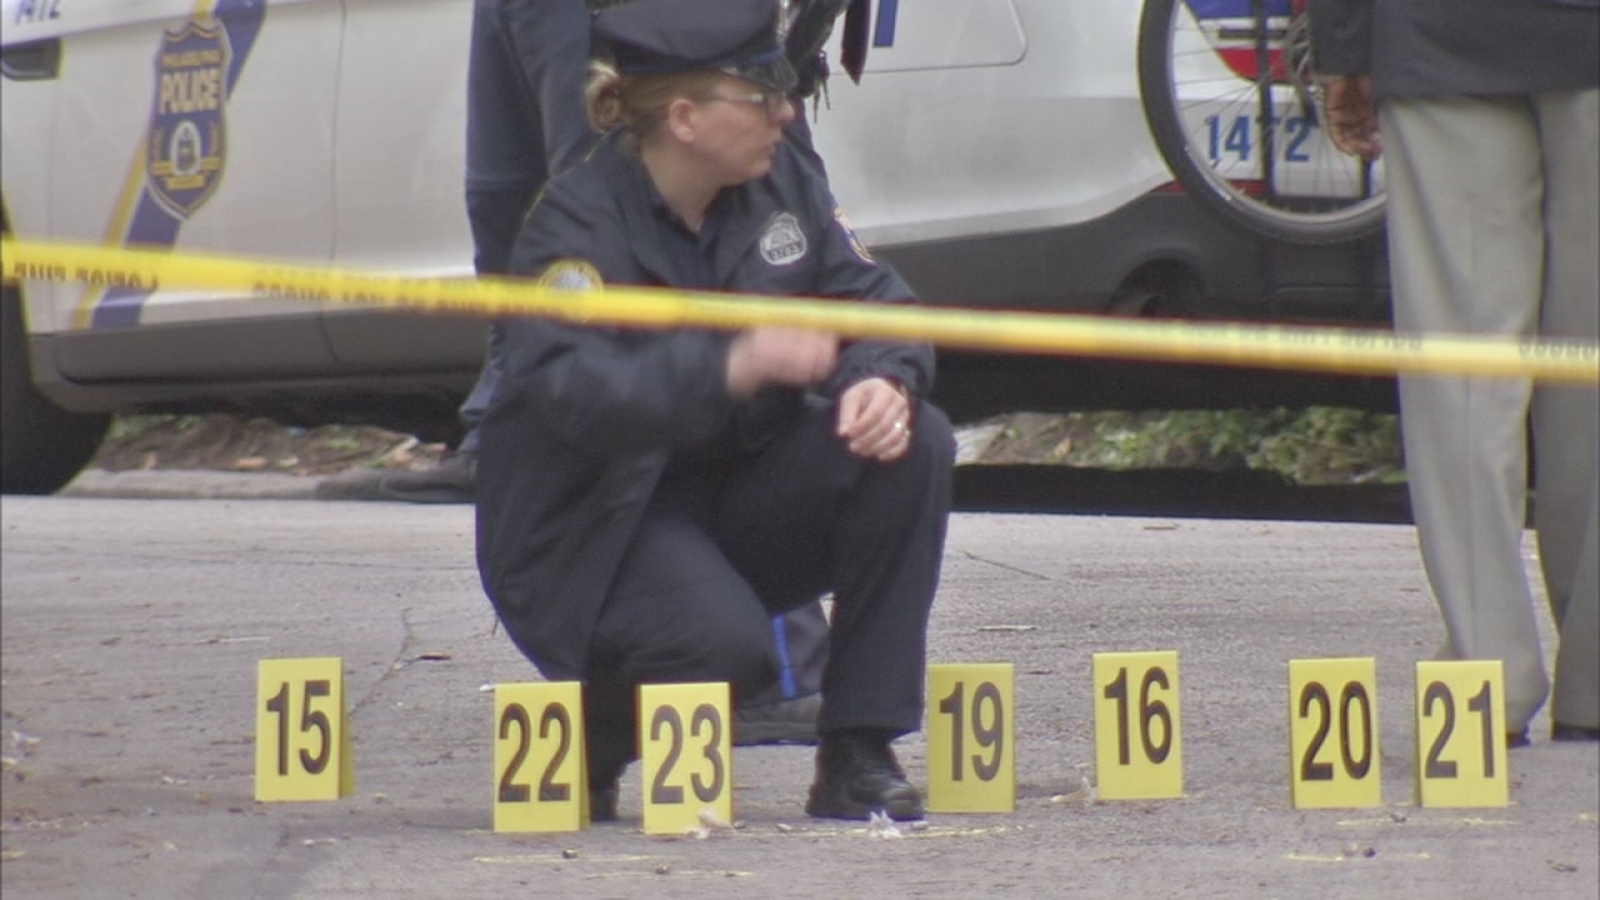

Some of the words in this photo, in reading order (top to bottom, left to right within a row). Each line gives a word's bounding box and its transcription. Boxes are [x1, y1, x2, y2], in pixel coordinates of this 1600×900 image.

[160, 68, 220, 114] POLICE
[1205, 115, 1311, 162] 142
[266, 680, 332, 776] 15
[499, 702, 572, 802] 22
[650, 704, 726, 804] 23
[939, 681, 1002, 782] 19
[1103, 666, 1173, 766] 16
[1299, 681, 1373, 781] 20
[1423, 680, 1496, 779] 21
